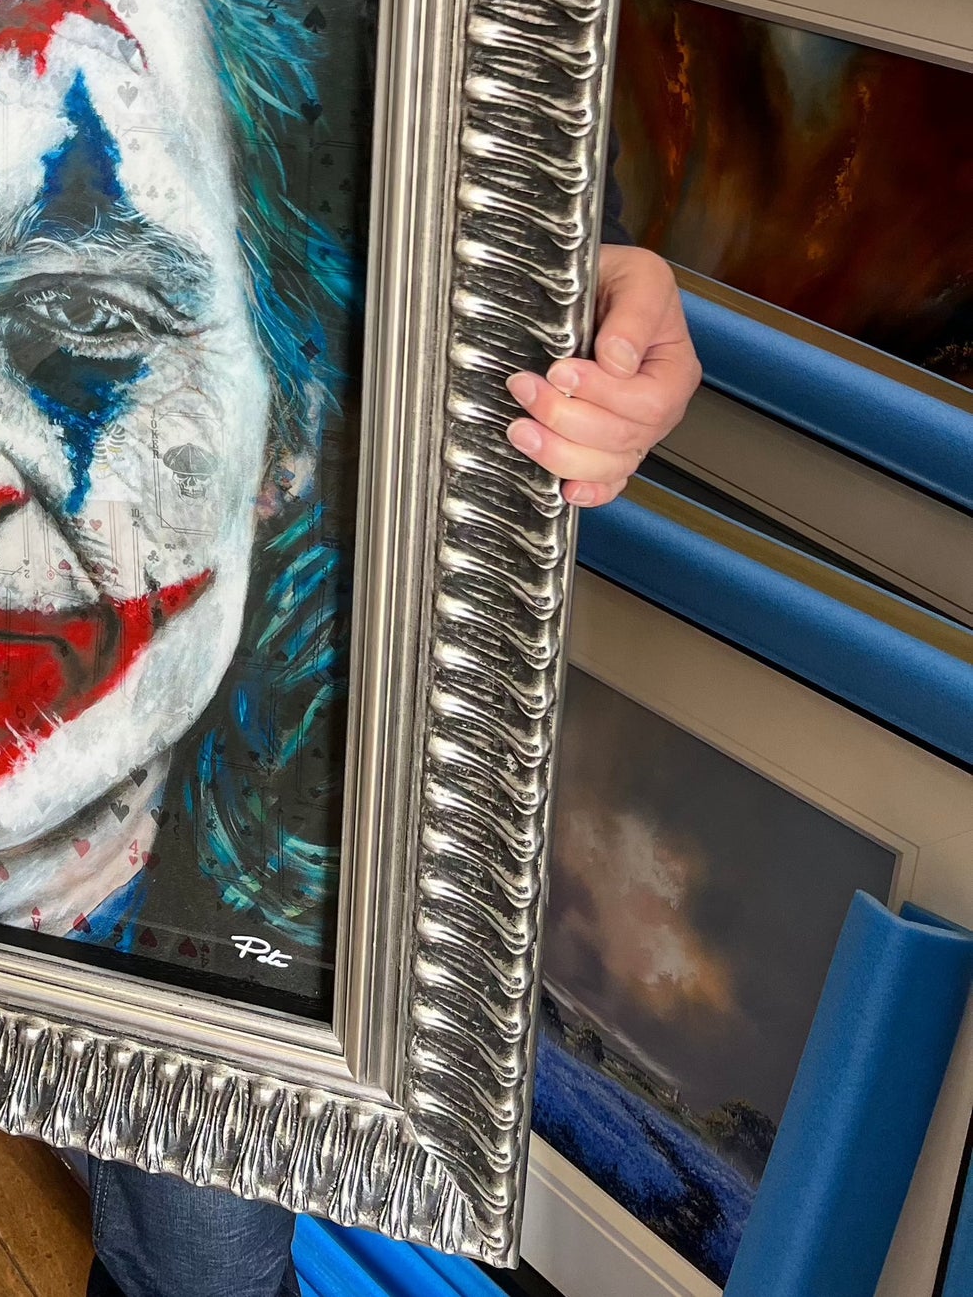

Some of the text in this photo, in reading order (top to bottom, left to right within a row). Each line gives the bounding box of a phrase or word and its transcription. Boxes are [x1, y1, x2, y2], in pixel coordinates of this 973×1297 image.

[150, 407, 160, 460] JOKER
[131, 509, 140, 518] 10
[129, 839, 138, 855] 4
[30, 917, 42, 932] A
